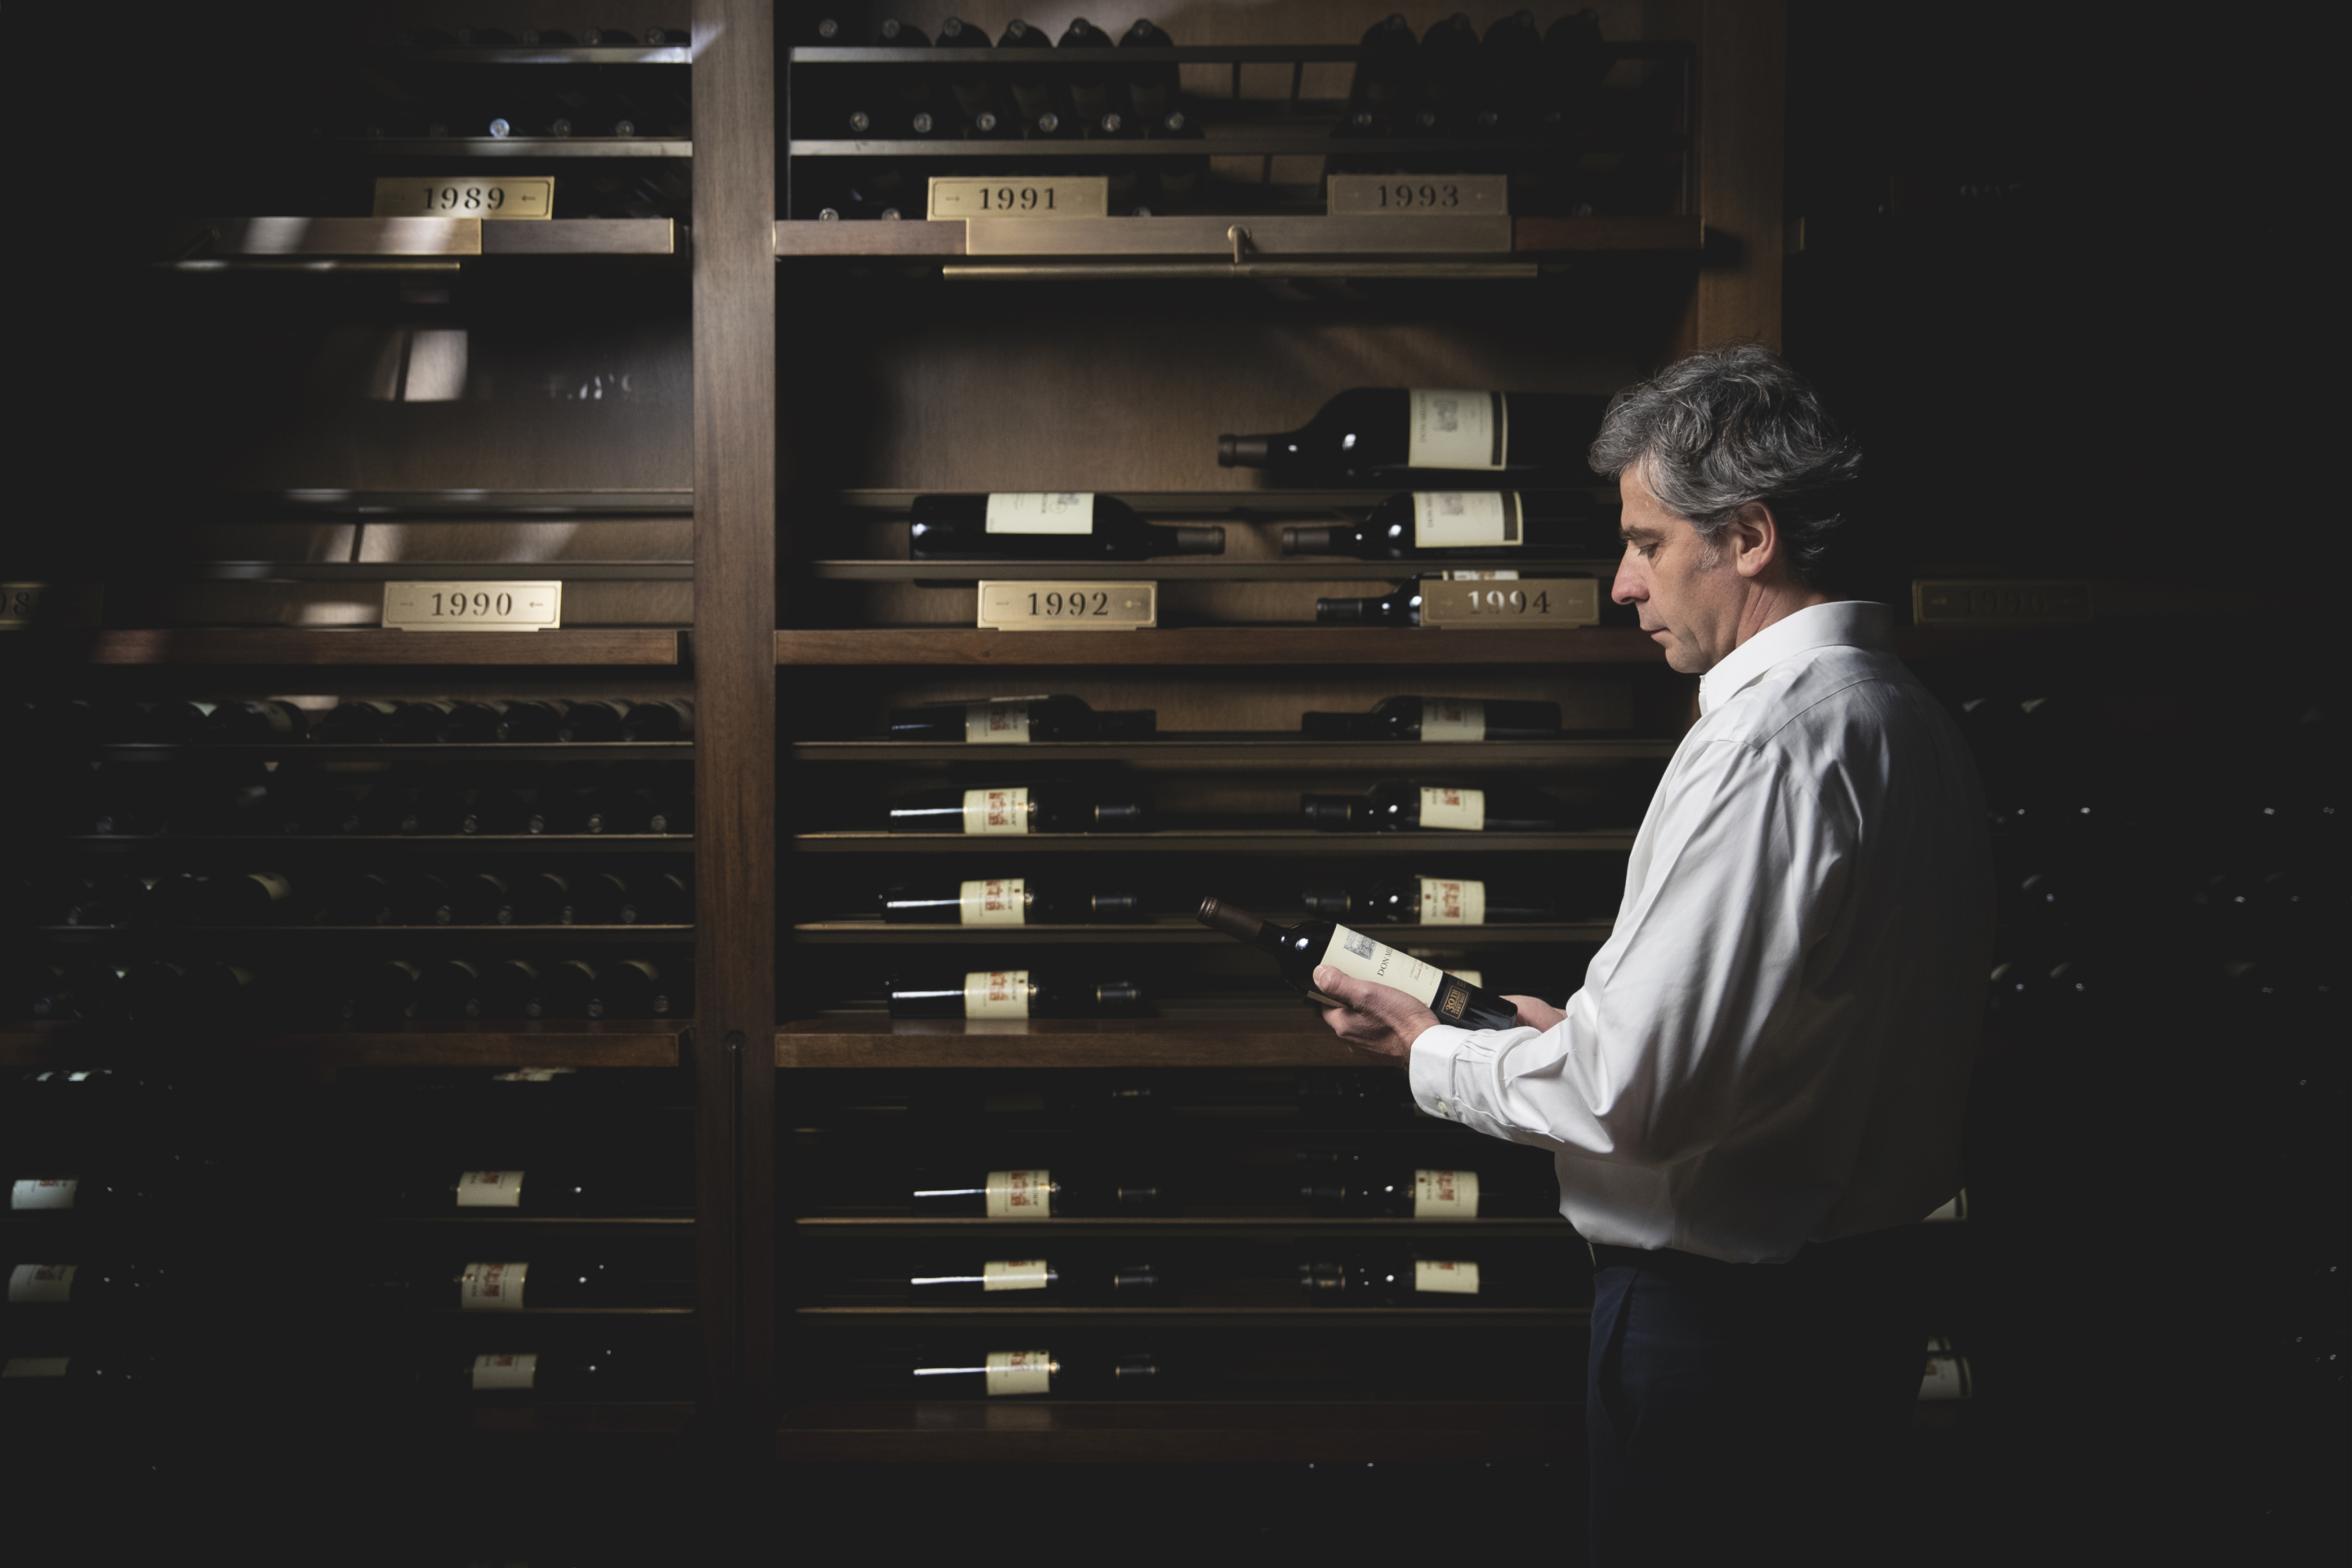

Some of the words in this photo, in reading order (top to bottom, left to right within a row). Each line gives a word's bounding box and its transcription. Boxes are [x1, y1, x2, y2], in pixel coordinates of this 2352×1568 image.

[421, 186, 506, 212] 1989
[978, 187, 1059, 212] 1991
[1377, 183, 1461, 209] 1993
[430, 592, 514, 618] 1990
[1027, 591, 1110, 617] 1992
[1467, 589, 1553, 615] 1994
[1965, 590, 2049, 615] 1996
[1377, 956, 1390, 977] DON
[1445, 989, 1459, 1013] 30TH
